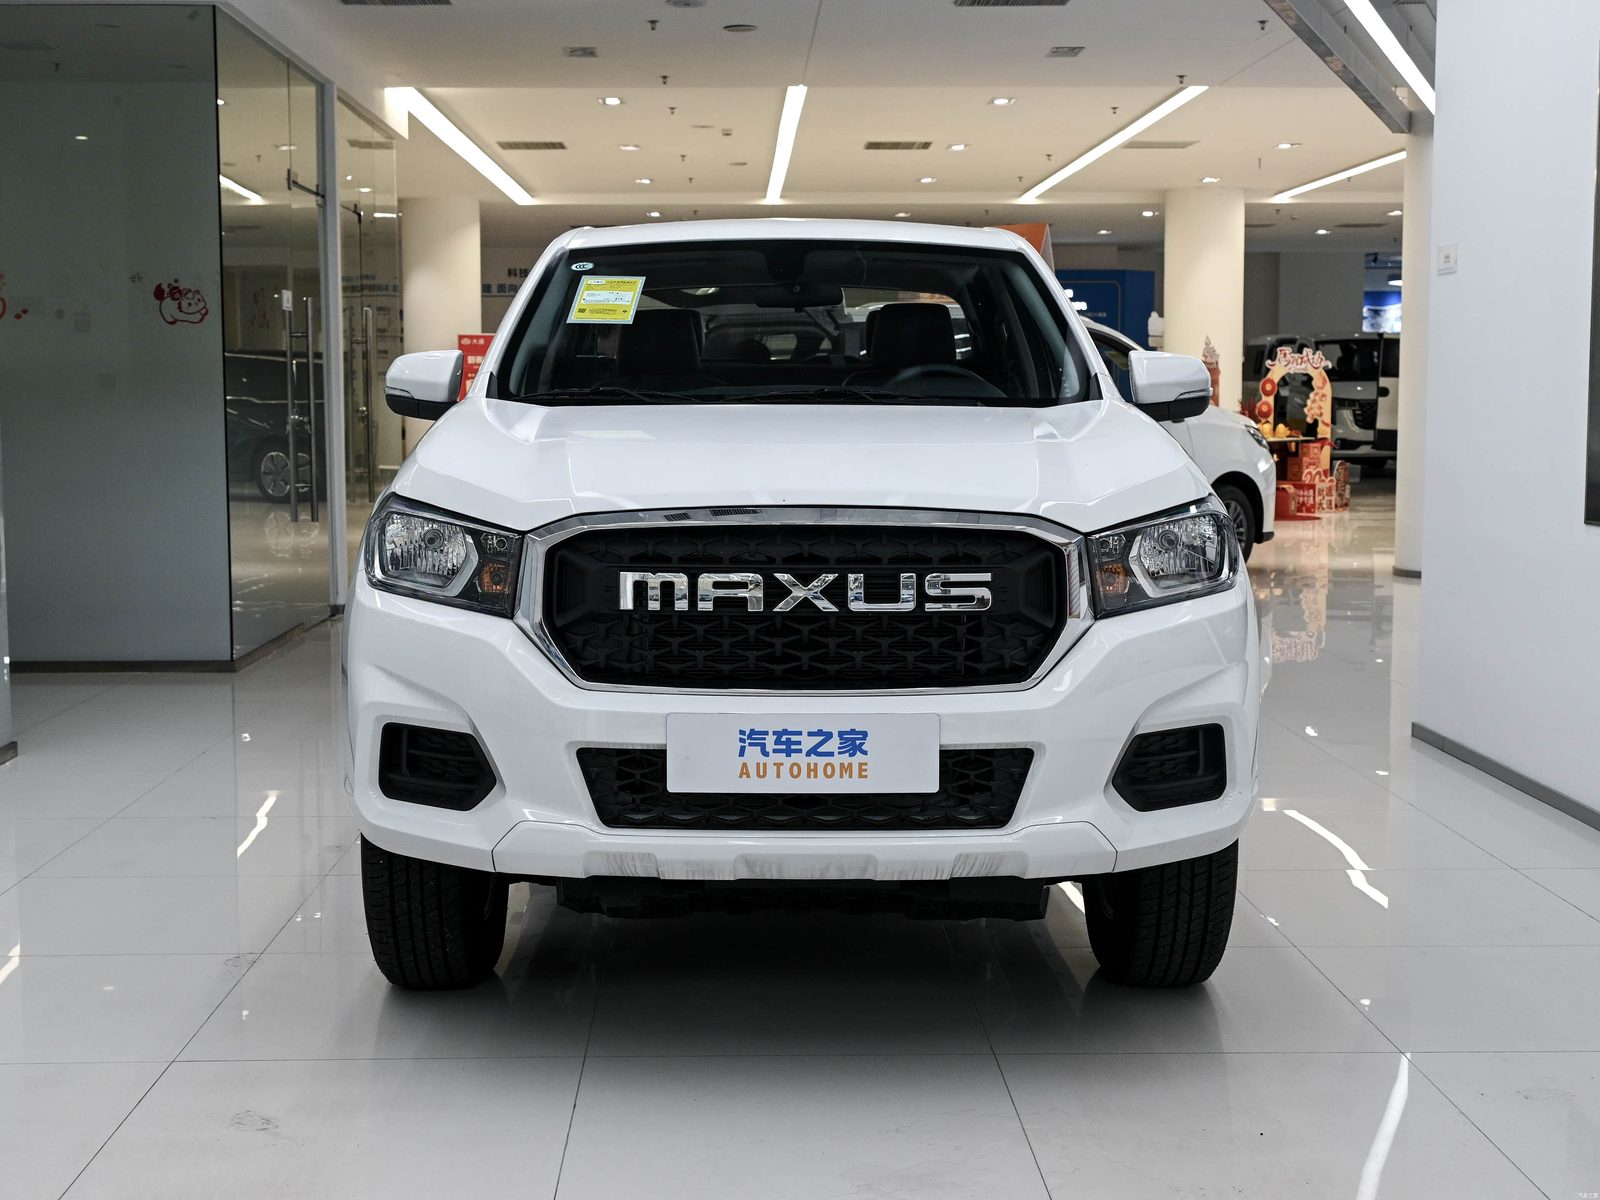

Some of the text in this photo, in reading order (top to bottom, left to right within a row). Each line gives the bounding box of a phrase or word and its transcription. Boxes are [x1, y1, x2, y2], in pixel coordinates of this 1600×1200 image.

[619, 571, 992, 612] MAXUS
[738, 728, 869, 758] 汽车之家
[738, 762, 869, 779] AUTOHOME
